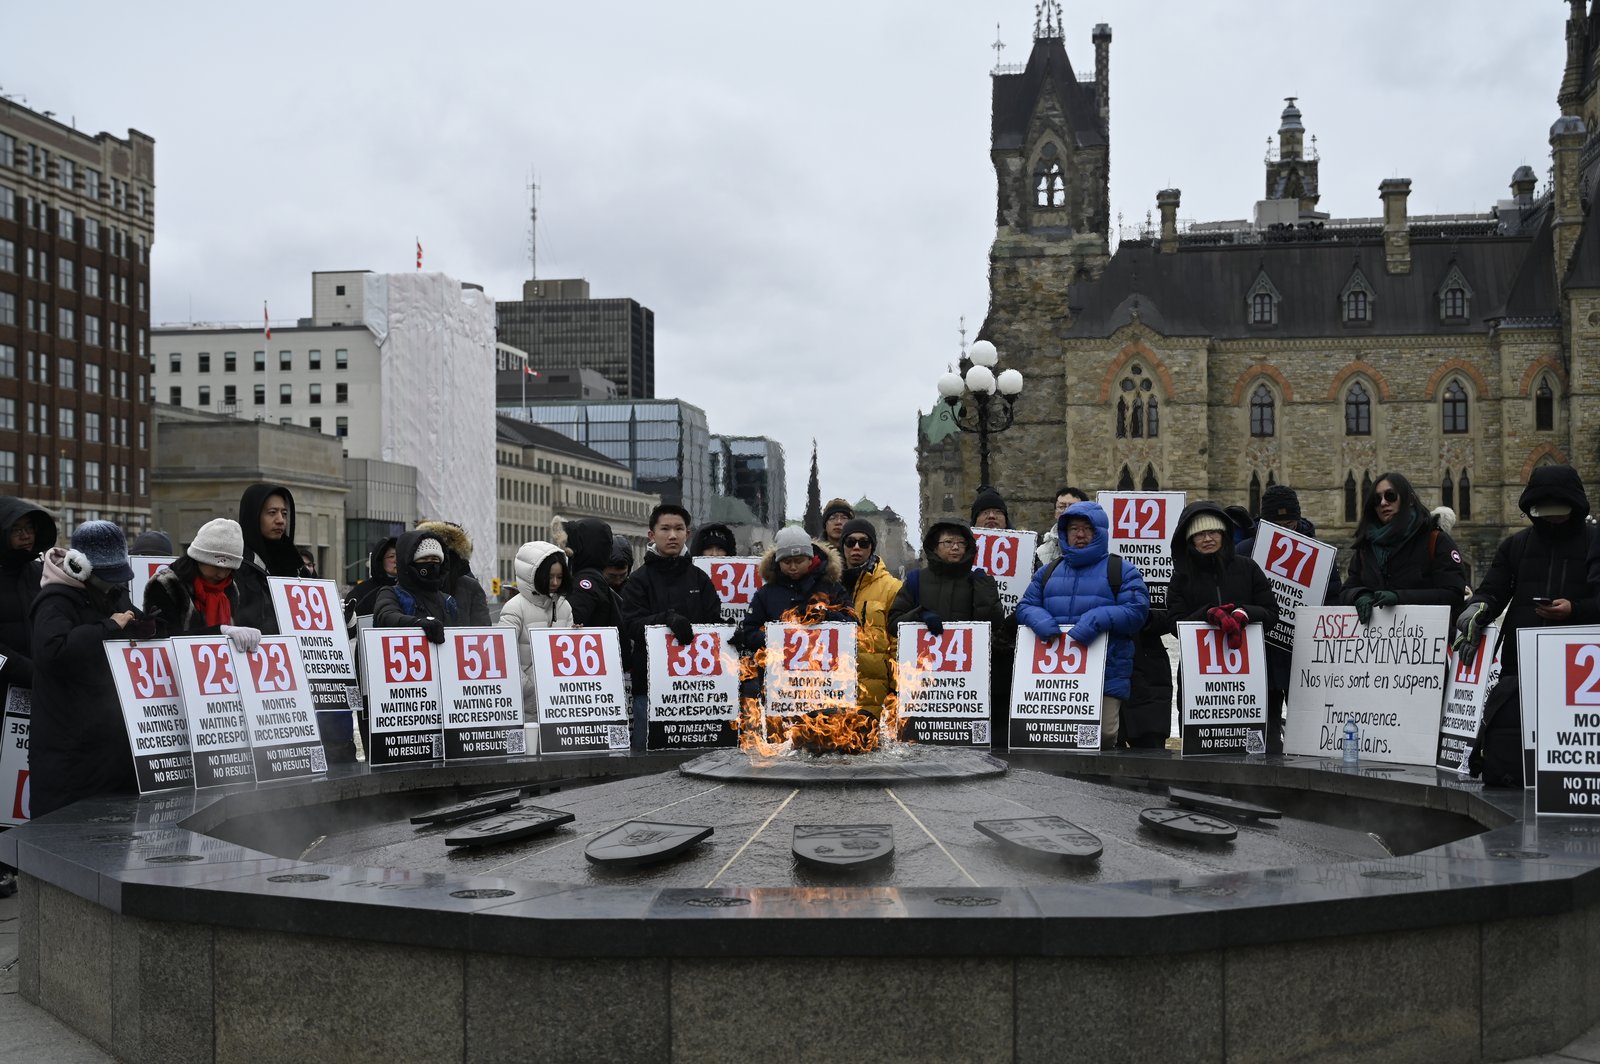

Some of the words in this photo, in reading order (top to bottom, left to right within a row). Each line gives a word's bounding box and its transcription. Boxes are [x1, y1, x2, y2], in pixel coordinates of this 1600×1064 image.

[1118, 500, 1160, 538] 42
[971, 535, 1011, 575] 16
[1120, 544, 1161, 554] MONTHS
[1153, 557, 1172, 566] FOR
[1271, 536, 1314, 582] 27
[717, 564, 757, 603] 34
[292, 586, 328, 630] 39
[1313, 614, 1360, 639] ASSEZ
[1363, 625, 1382, 639] des
[1388, 614, 1424, 638] délais
[300, 636, 333, 647] MONTHS
[300, 650, 328, 660] AITING
[328, 650, 344, 660] FOR
[556, 635, 600, 676] 36
[672, 634, 714, 676] 38
[790, 630, 832, 670] 24
[922, 630, 967, 670] 34
[1038, 634, 1081, 673] 35
[1204, 630, 1242, 673] 16
[1312, 637, 1445, 665] INTERMINABLE
[388, 636, 427, 682] 55
[463, 636, 501, 679] 51
[130, 648, 172, 698] 34
[198, 645, 237, 693] 23
[252, 644, 291, 691] 23
[312, 664, 350, 674] RESPONSE
[315, 683, 346, 692] TIMELINES
[559, 682, 602, 692] MONTHS
[672, 680, 715, 691] MONTHS
[921, 678, 966, 687] MONTHS
[1036, 679, 1079, 689] MONTHS
[1206, 682, 1245, 692] MONTHS
[1301, 669, 1320, 687] Nos
[1324, 673, 1344, 688] vies
[1347, 672, 1370, 688] sont
[1374, 675, 1389, 689] en
[1393, 674, 1442, 694] suspens.
[390, 688, 427, 699] MONTHS
[462, 684, 501, 696] MONTHS
[911, 691, 954, 700] WAITING
[957, 690, 978, 700] FOR
[320, 694, 346, 703] RESULTS
[550, 694, 592, 705] WAITING
[595, 694, 614, 703] FOR
[662, 693, 704, 704] WAITING
[707, 692, 728, 702] FOR
[1024, 692, 1066, 702] WAITING
[1069, 692, 1089, 702] FOR
[1195, 695, 1236, 705] WAITING
[1238, 695, 1256, 705] FOR
[262, 698, 297, 711] MONTHS
[381, 702, 418, 713] WAITING
[420, 701, 437, 711] FOR
[454, 698, 492, 709] WAITING
[495, 698, 512, 707] FOR
[904, 703, 927, 712] IRCC
[928, 703, 983, 712] RESPONSE
[1017, 704, 1039, 714] IRCC
[1041, 705, 1094, 715] RESPONSE
[143, 704, 179, 717] MONTHS
[545, 708, 568, 718] IRCC
[569, 706, 621, 717] RESPONSE
[655, 707, 678, 717] IRCC
[679, 705, 733, 716] RESPONSE
[1190, 710, 1210, 719] IRCC
[1213, 708, 1261, 719] RESPONSE
[1325, 704, 1400, 726] Transparence.
[1465, 705, 1476, 716] FOR
[199, 716, 237, 730] WAITING
[256, 712, 291, 726] WAITING
[292, 711, 308, 723] FOR
[376, 717, 396, 727] IRCC
[397, 714, 441, 726] RESPONSE
[449, 713, 469, 724] IRCC
[471, 710, 518, 722] RESPONSE
[138, 720, 173, 734] WAITING
[556, 727, 568, 735] NO
[570, 725, 608, 734] TIMELINE
[664, 725, 676, 733] NO
[679, 724, 722, 732] TIMELINES
[928, 721, 972, 730] TIMELINES
[1026, 723, 1038, 731] NO
[1039, 723, 1080, 732] TIMELINE
[1451, 718, 1476, 732] RESPONSE
[254, 730, 274, 741] IRCC
[274, 725, 315, 739] RESPONSE
[460, 732, 470, 741] NO
[472, 730, 509, 740] TIMELINES
[668, 735, 680, 744] NO
[682, 734, 718, 742] RESULTS
[932, 732, 969, 740] RESULTS
[1029, 734, 1040, 742] NO
[1043, 734, 1078, 742] RESULTS
[1199, 729, 1210, 737] NO
[136, 738, 155, 750] IRCC
[196, 734, 217, 746] IRCC
[385, 737, 396, 745] NO
[396, 734, 433, 745] TIMELINES
[561, 737, 572, 745] NO
[574, 736, 609, 744] RESULTS
[1202, 740, 1212, 748] NO
[1214, 738, 1246, 747] RESULTS
[1358, 730, 1391, 753] lairs.
[388, 748, 398, 757] NO
[400, 746, 430, 755] RESULTS
[463, 743, 473, 751] NO
[476, 741, 507, 751] RESULTS
[267, 750, 277, 760] NO
[278, 747, 311, 758] TIMELINES
[1440, 750, 1446, 759] NO
[1547, 750, 1582, 764] IRCC
[149, 759, 159, 770] NO
[208, 756, 219, 766] NO
[272, 762, 282, 772] NO
[282, 758, 310, 771] RESULTS
[154, 772, 165, 782] NO
[166, 769, 194, 781] RESULTS
[213, 768, 224, 778] NO
[1564, 777, 1581, 789] NO
[1569, 793, 1587, 805] NO
